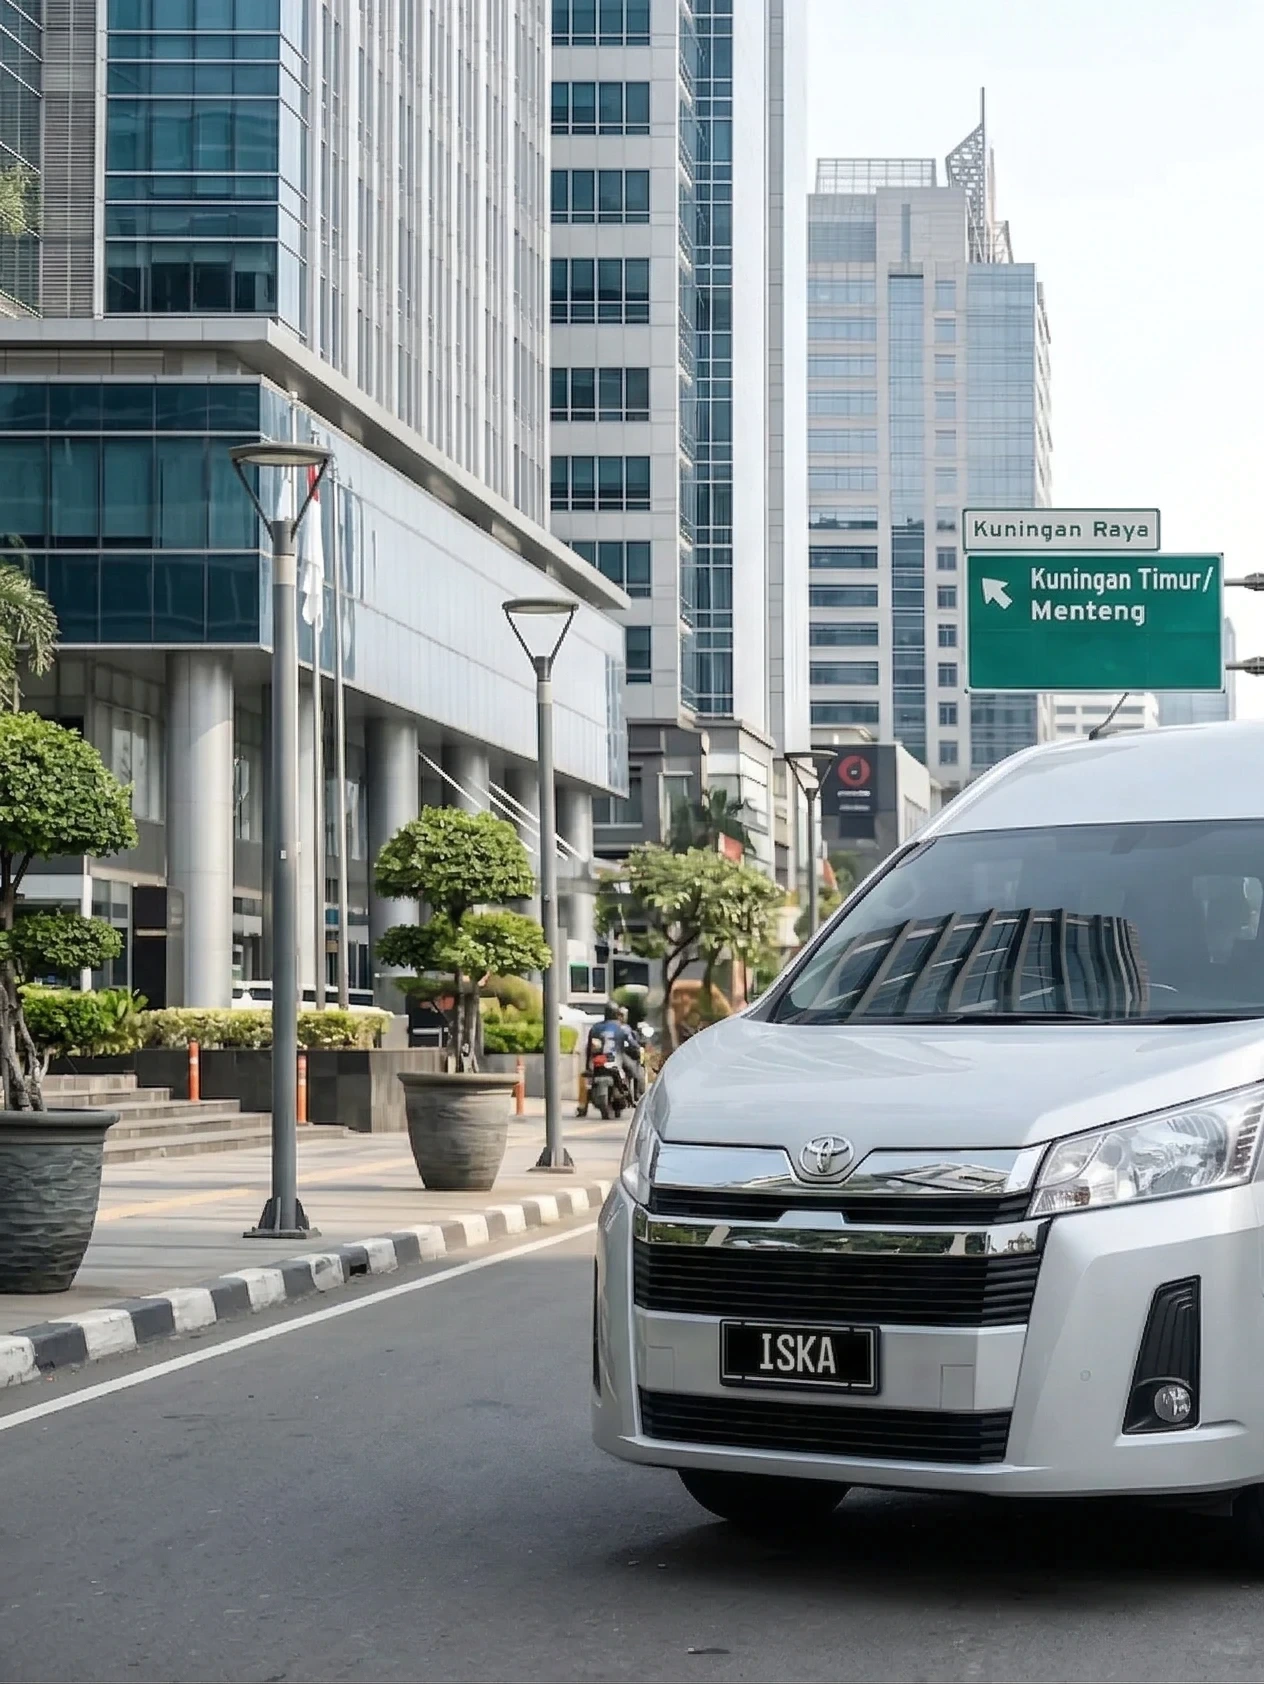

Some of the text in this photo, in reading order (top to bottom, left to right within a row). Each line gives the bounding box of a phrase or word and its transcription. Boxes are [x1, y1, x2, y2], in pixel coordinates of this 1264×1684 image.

[974, 520, 1149, 542] Kuningan Raya
[1031, 566, 1214, 595] Kuningan Timur/
[1031, 600, 1145, 626] Menteng
[760, 1333, 836, 1374] ISKA
